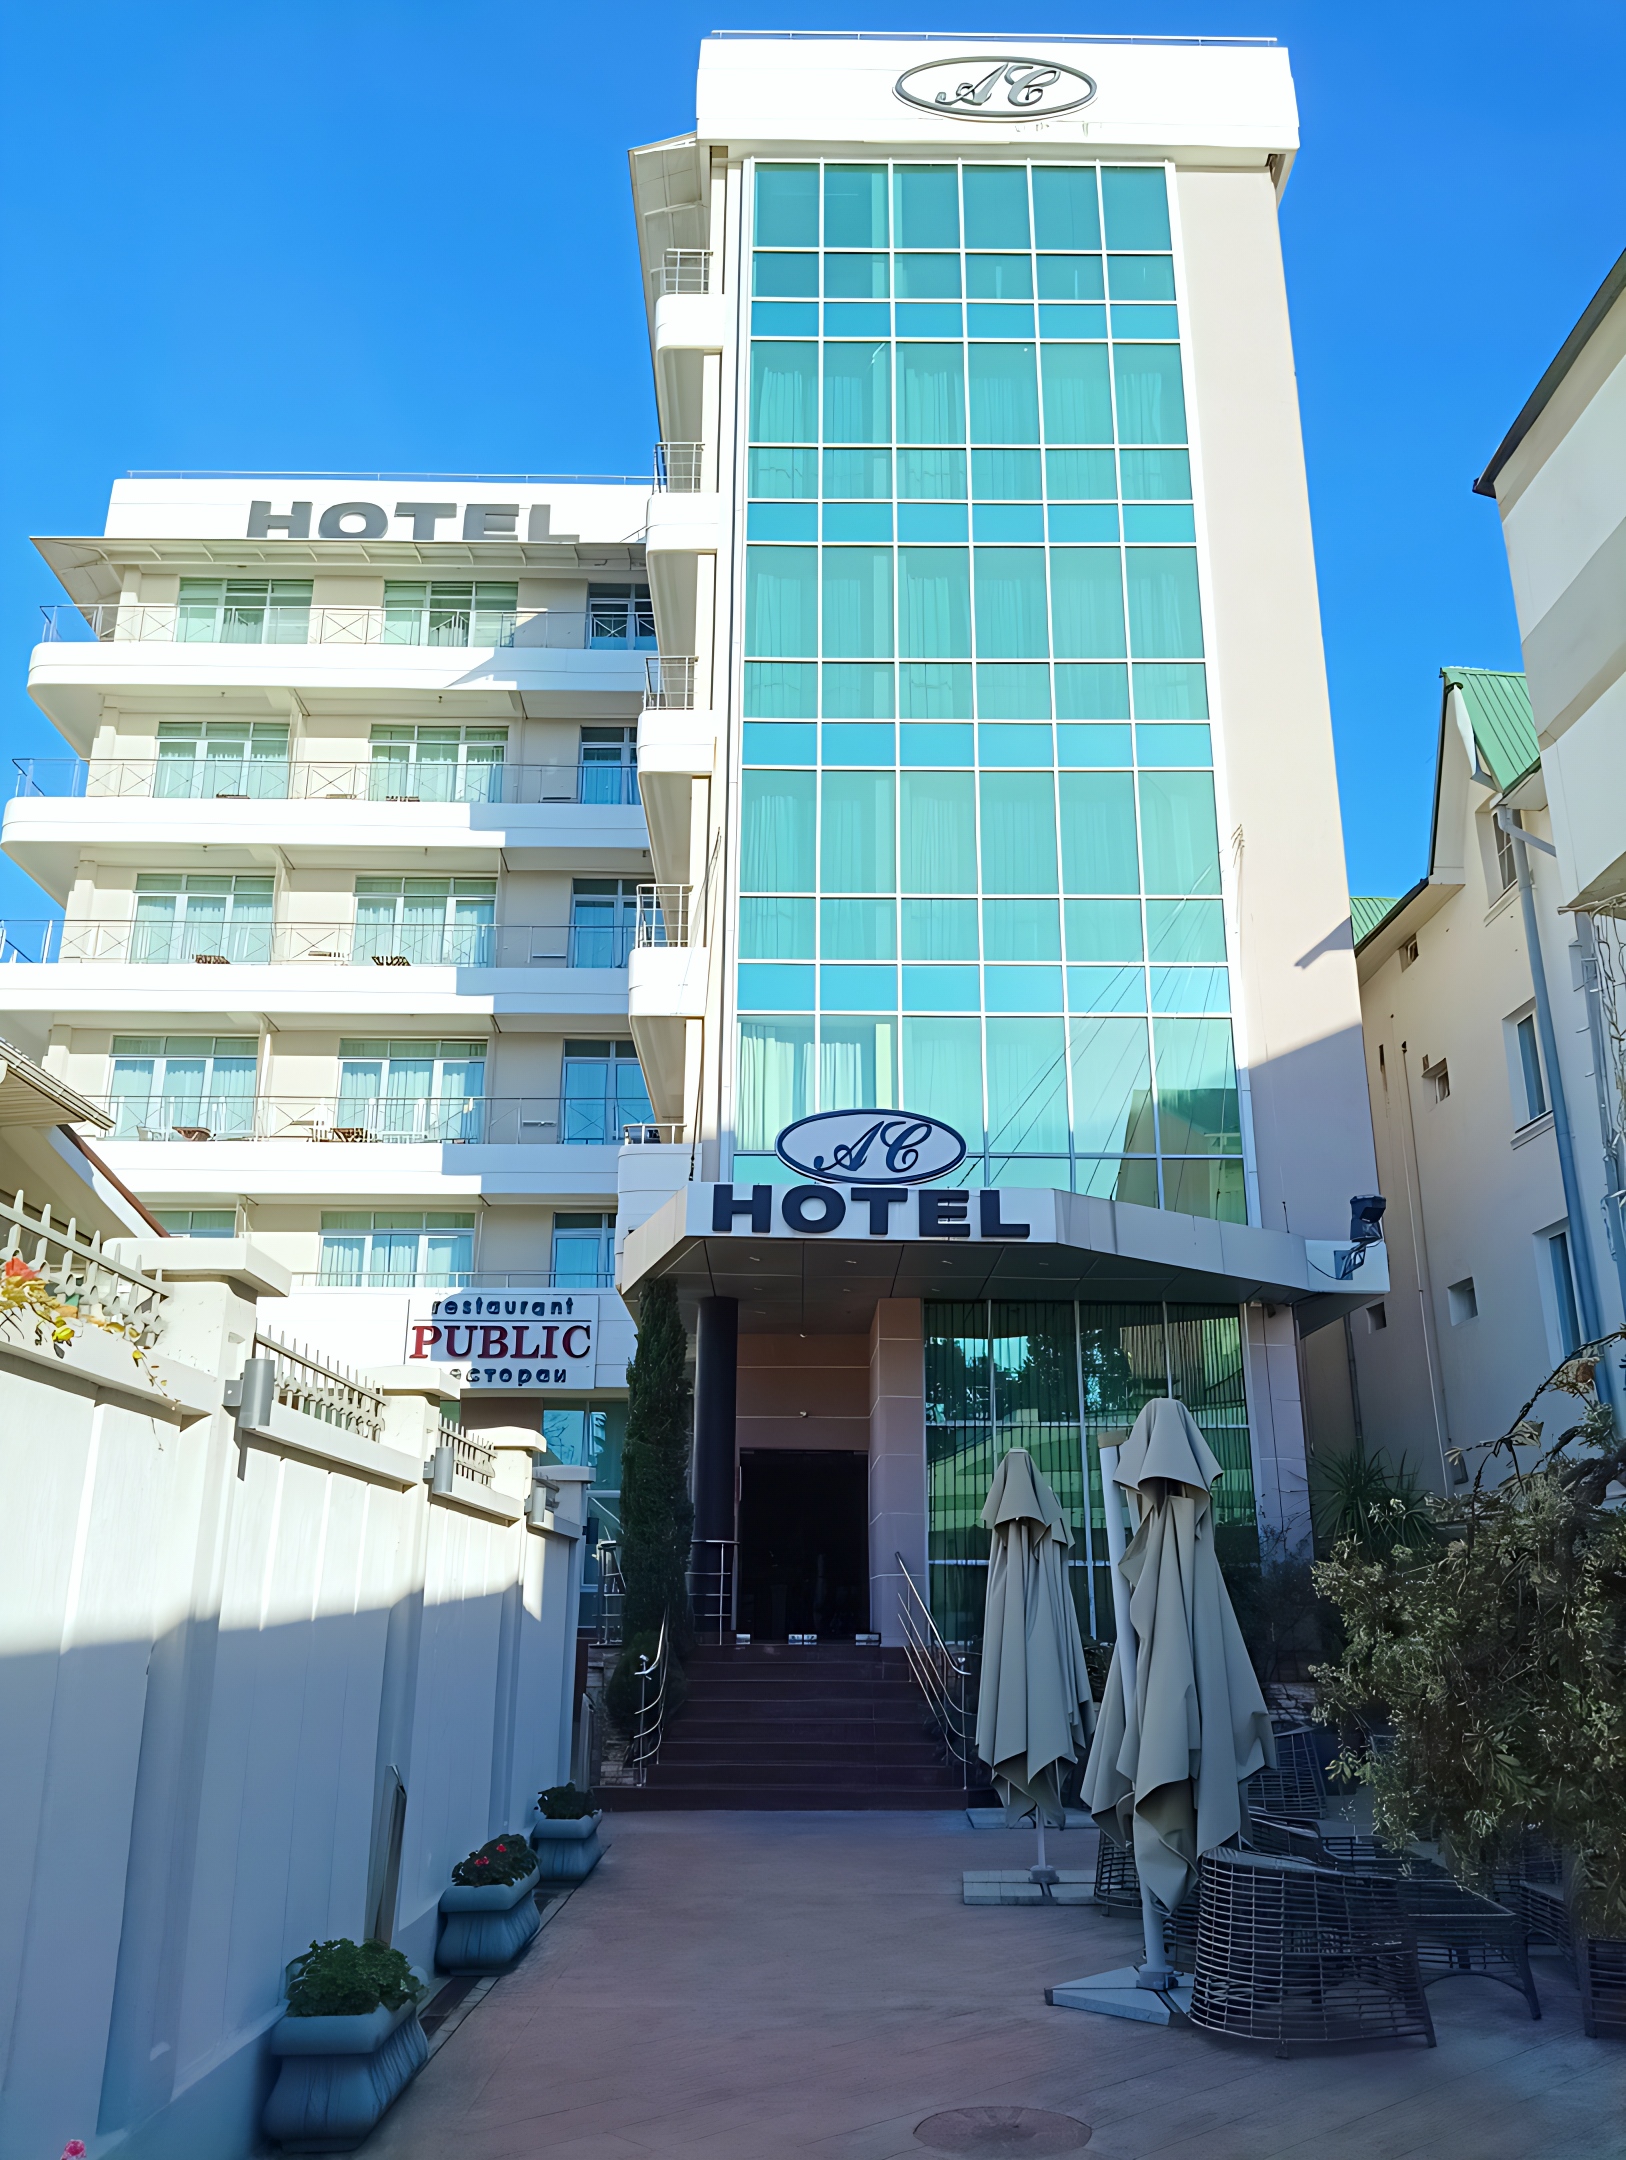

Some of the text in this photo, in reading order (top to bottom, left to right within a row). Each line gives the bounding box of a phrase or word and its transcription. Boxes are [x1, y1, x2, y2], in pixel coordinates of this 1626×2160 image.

[934, 62, 1061, 107] AC
[246, 500, 580, 543] HOTEL
[813, 1120, 932, 1173] AC
[712, 1184, 1030, 1238] HOTEL
[431, 1297, 574, 1316] restaurant
[409, 1325, 591, 1359] PUBLIC
